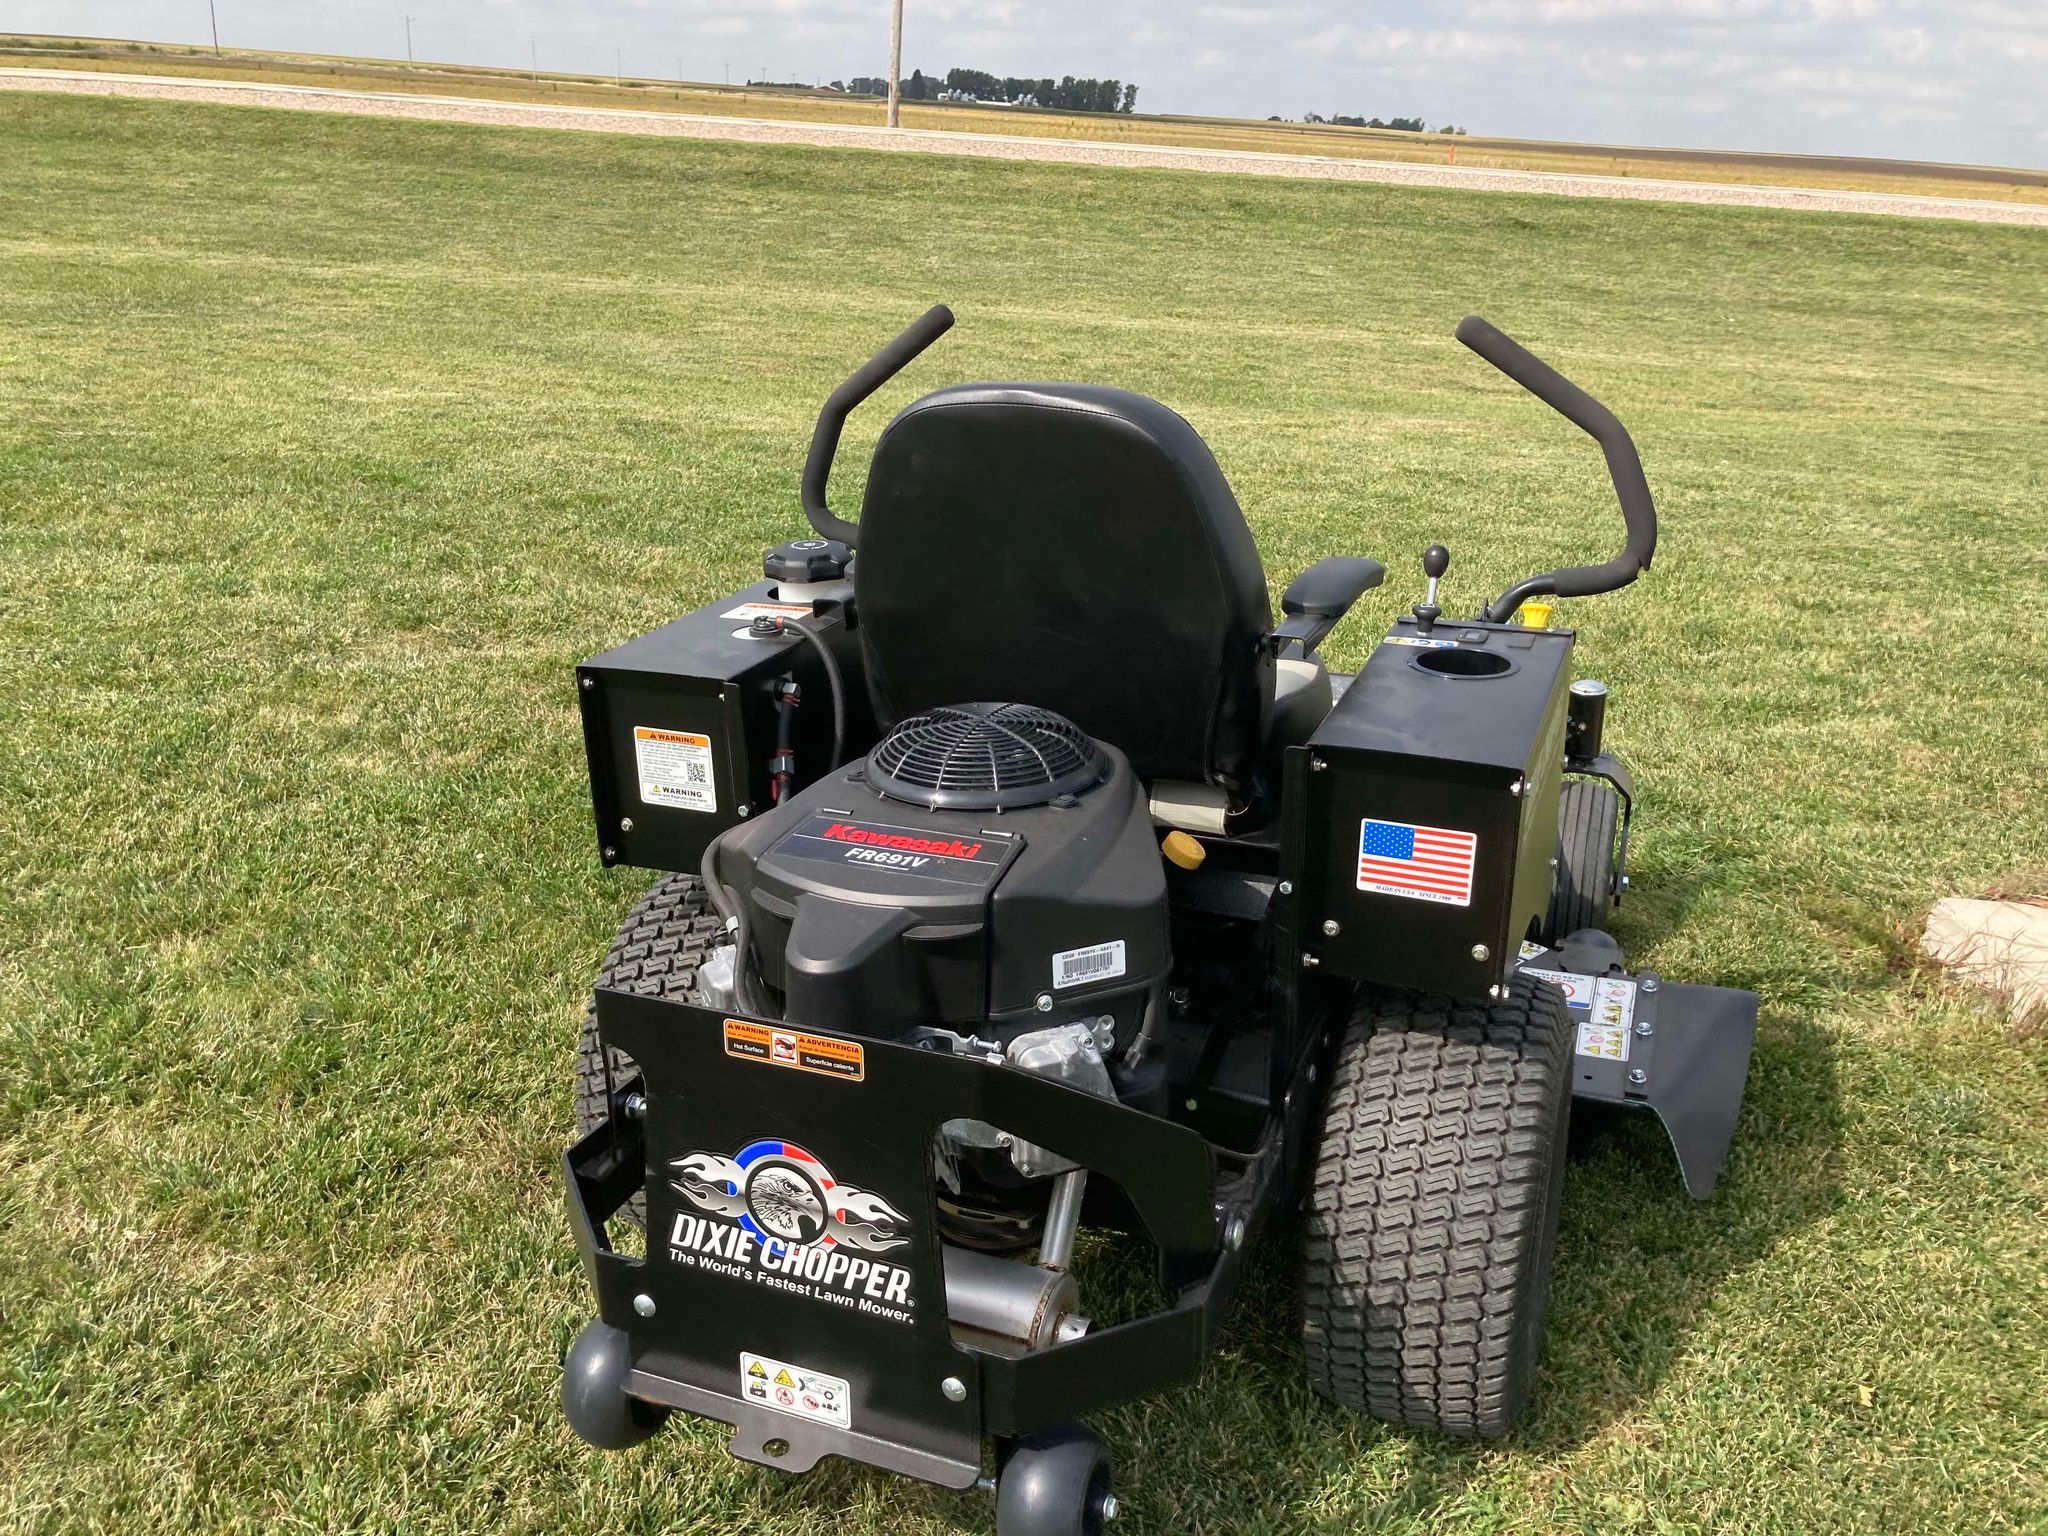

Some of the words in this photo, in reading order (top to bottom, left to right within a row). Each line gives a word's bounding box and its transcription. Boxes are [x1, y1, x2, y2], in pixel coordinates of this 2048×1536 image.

[658, 734, 695, 744] WARNING
[662, 786, 703, 798] WARNING
[823, 823, 982, 859] Kawasaki
[844, 847, 930, 868] FR691V
[735, 1024, 769, 1036] WARNING
[733, 1042, 744, 1050] Hot
[744, 1044, 765, 1055] Surface
[807, 1038, 860, 1054] ADVERTENCIA
[805, 1056, 833, 1068] Superficie
[670, 1213, 758, 1263] DIXIE
[760, 1237, 912, 1306] CHOPPER
[669, 1248, 695, 1266] The
[697, 1255, 753, 1281] World's
[757, 1270, 812, 1296] Fastest
[814, 1286, 855, 1308] Lawn
